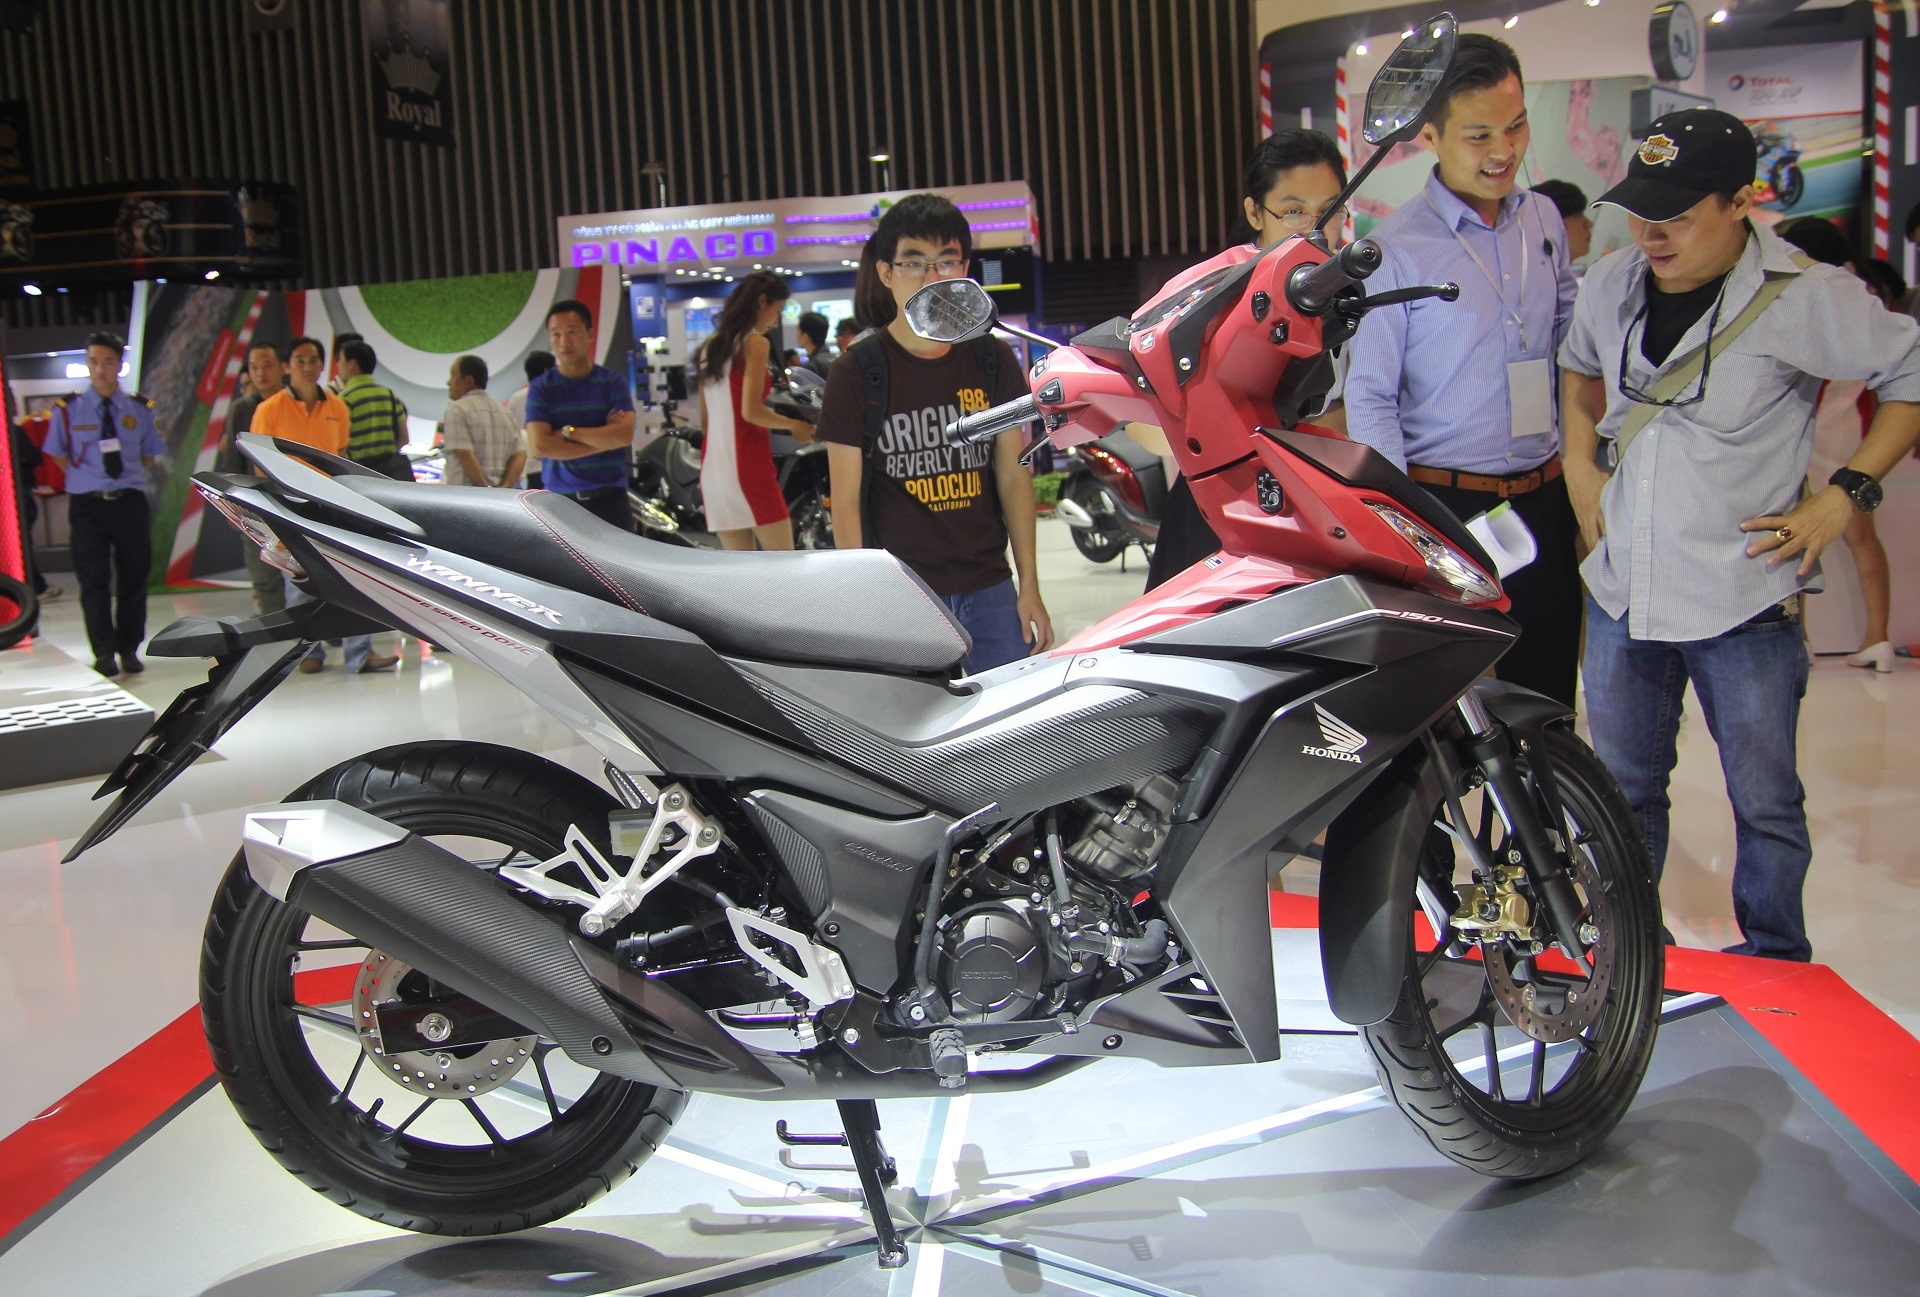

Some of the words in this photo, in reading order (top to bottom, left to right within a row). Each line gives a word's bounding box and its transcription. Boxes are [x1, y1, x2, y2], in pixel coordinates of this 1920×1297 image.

[1750, 76, 1794, 87] TOTAL
[386, 90, 441, 131] Royal
[572, 229, 775, 268] PINACO
[886, 446, 953, 478] BEVERLY
[960, 443, 990, 470] HILLS
[928, 499, 971, 512] CALIFORNIA
[407, 553, 565, 626] WINNER
[431, 607, 482, 631] SPEED
[480, 630, 536, 656] DOHC
[1399, 611, 1443, 623] 150
[1301, 745, 1363, 764] HONDA
